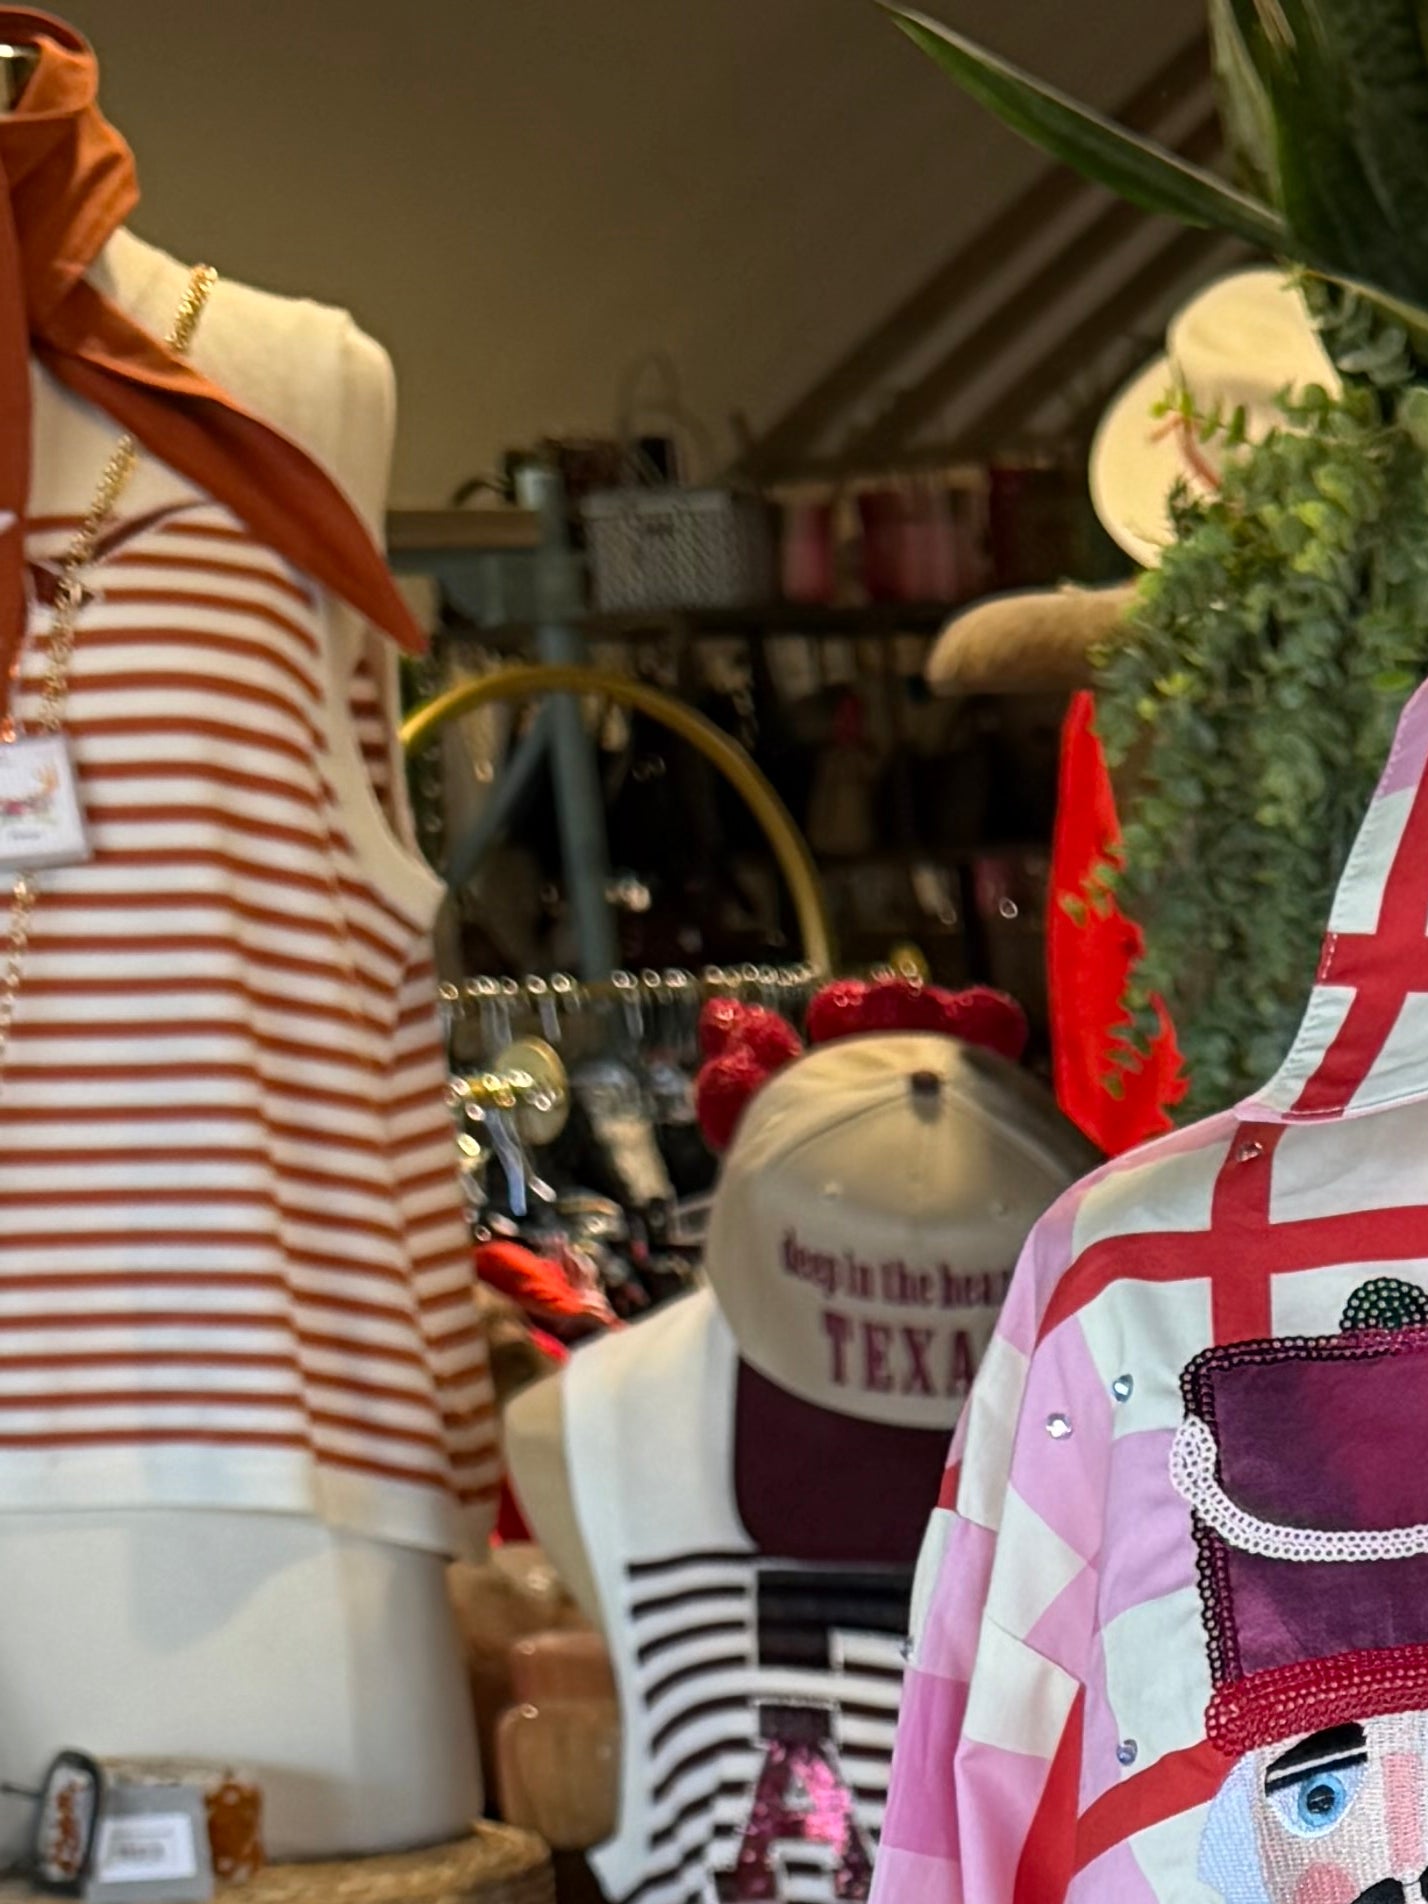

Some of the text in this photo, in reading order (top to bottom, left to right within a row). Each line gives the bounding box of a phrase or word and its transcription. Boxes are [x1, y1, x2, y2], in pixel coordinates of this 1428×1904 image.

[846, 1253, 873, 1298] in
[882, 1259, 933, 1306] the
[821, 1307, 976, 1397] TEXA
